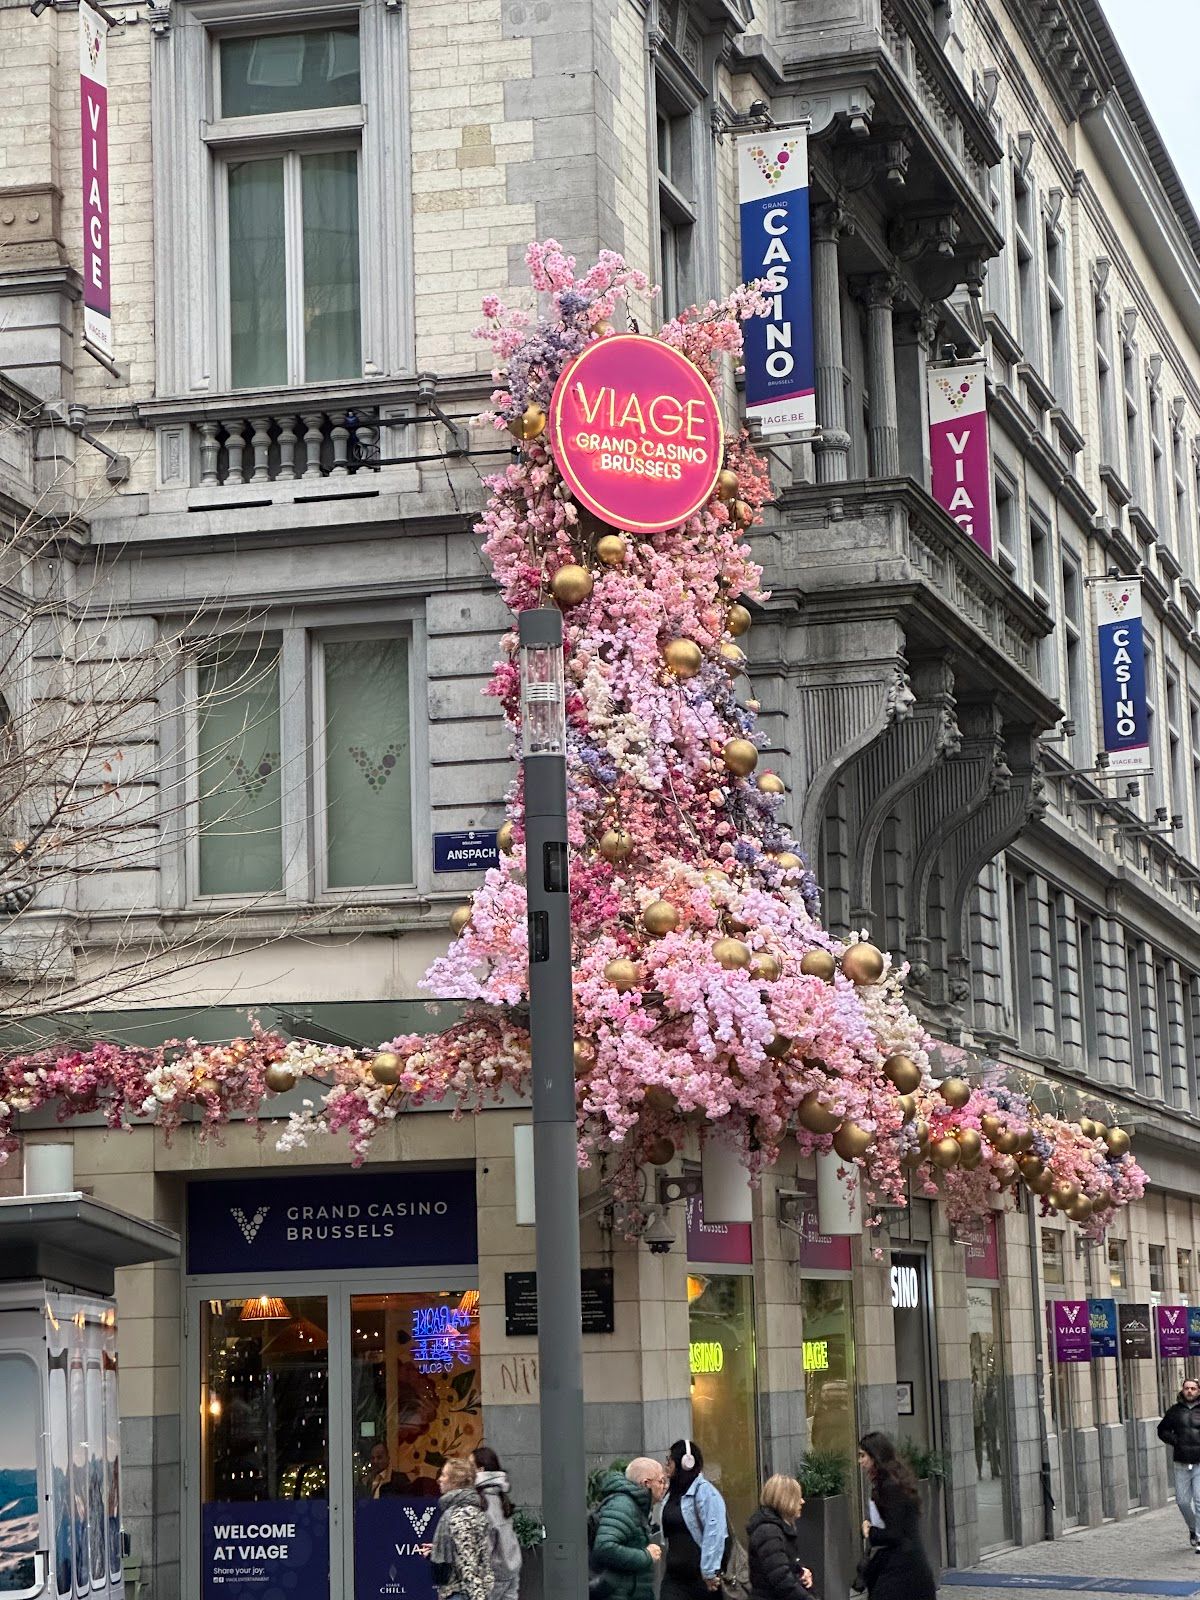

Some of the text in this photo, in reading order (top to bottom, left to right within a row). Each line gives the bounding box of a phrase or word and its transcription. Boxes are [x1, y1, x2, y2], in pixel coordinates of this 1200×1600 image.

[87, 96, 103, 289] VIAGE
[762, 201, 788, 209] GRAND
[762, 208, 794, 378] CASINO
[576, 382, 706, 441] VIAGE
[575, 432, 708, 464] GRAND CASINO
[602, 453, 681, 480] BRUSSELS
[1112, 629, 1136, 736] CASINO
[447, 848, 496, 861] ANSPACH
[286, 1201, 449, 1221] GRAND CASINO
[286, 1223, 395, 1241] BRUSSELS
[1059, 1326, 1087, 1334] VIAGE
[213, 1523, 296, 1540] WELCOME
[213, 1544, 288, 1561] AT VIAGE
[213, 1567, 235, 1575] Share
[235, 1568, 251, 1576] your
